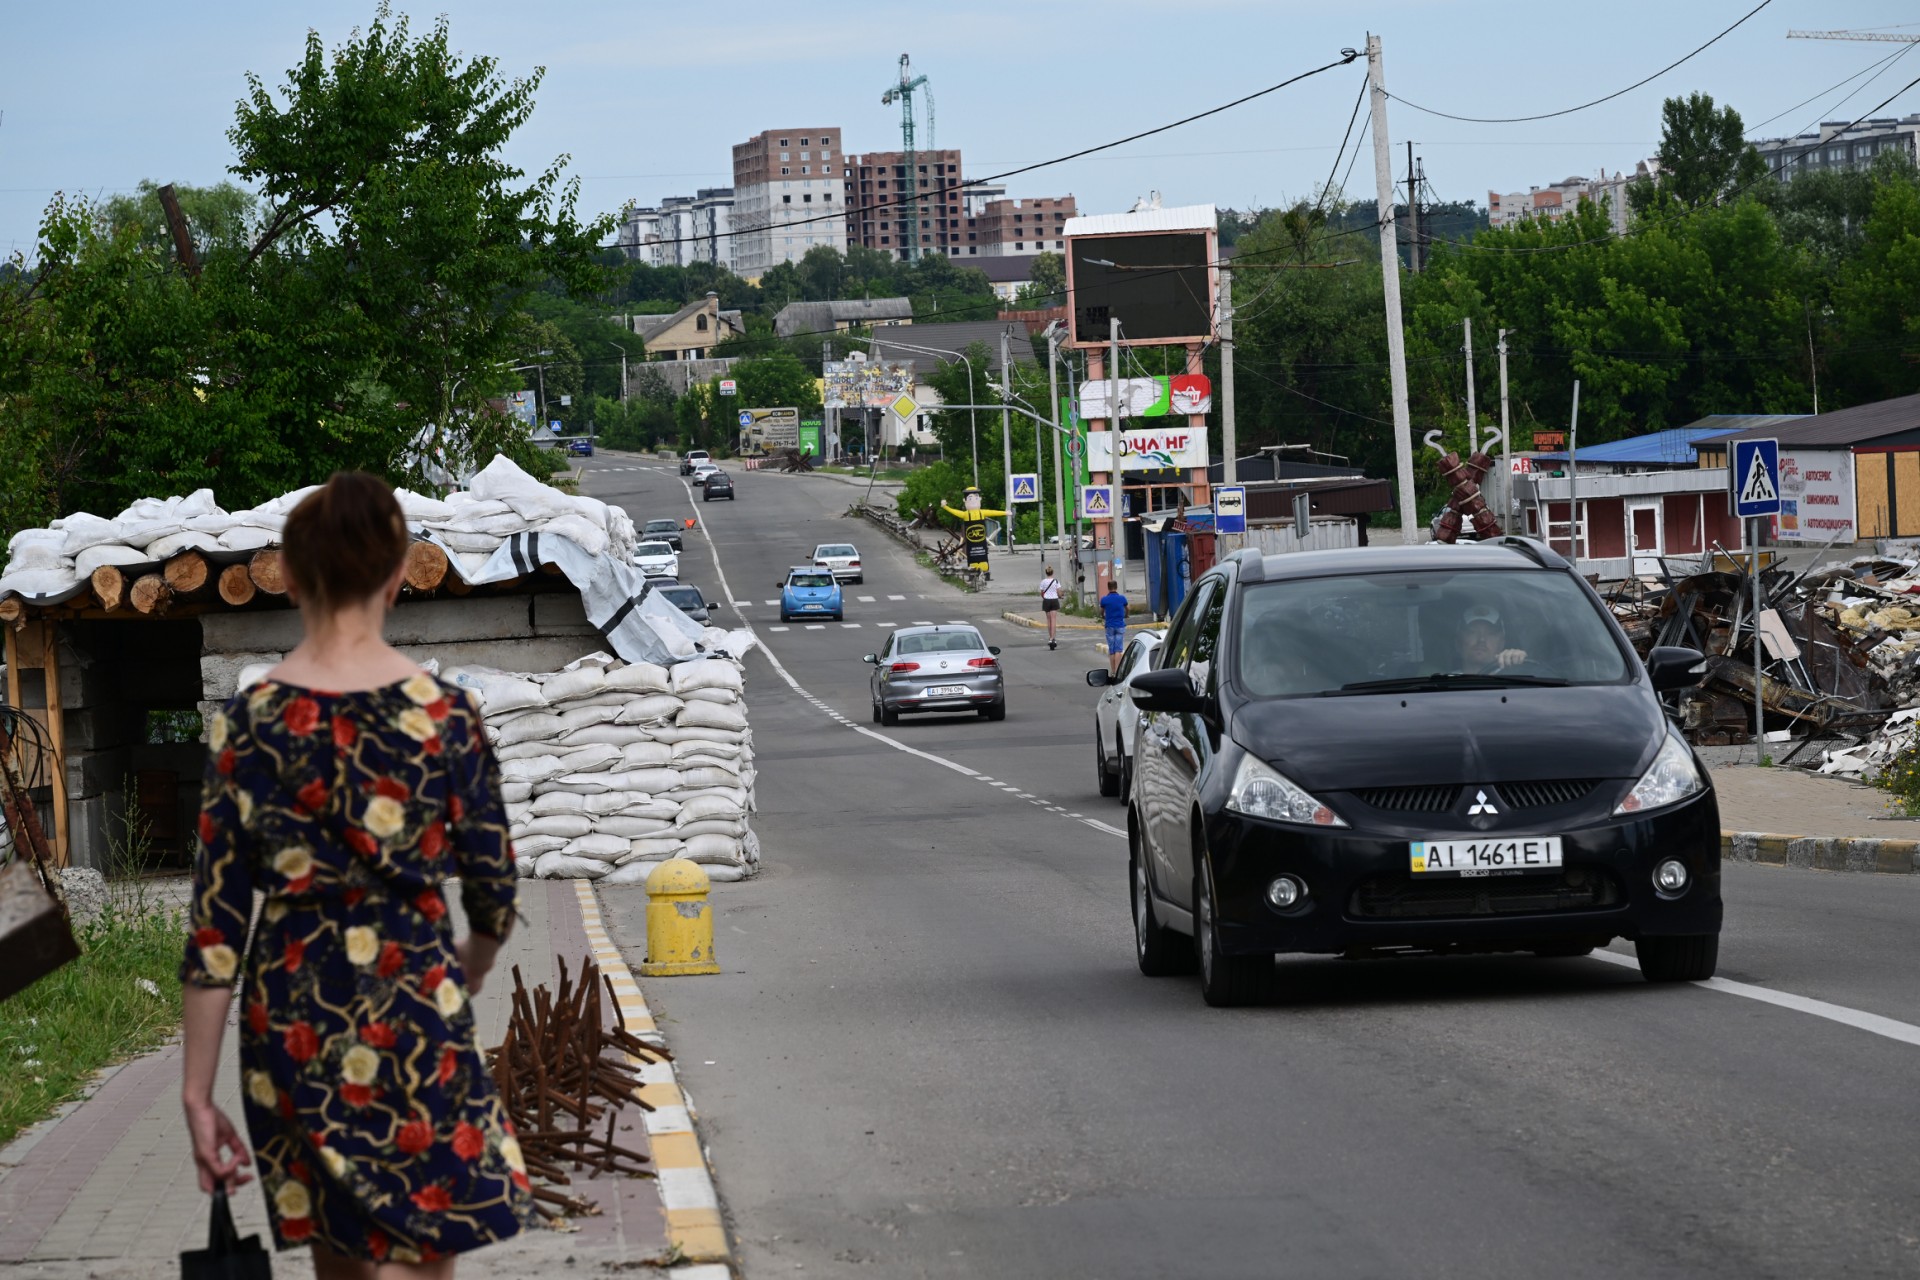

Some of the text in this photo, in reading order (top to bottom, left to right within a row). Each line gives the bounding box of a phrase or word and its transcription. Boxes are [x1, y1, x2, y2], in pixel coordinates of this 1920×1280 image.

[1106, 434, 1189, 455] УЛІНГ
[1805, 470, 1832, 481] АВТОСЕРВІС
[1806, 494, 1840, 505] ШИНОМОНТАЖ
